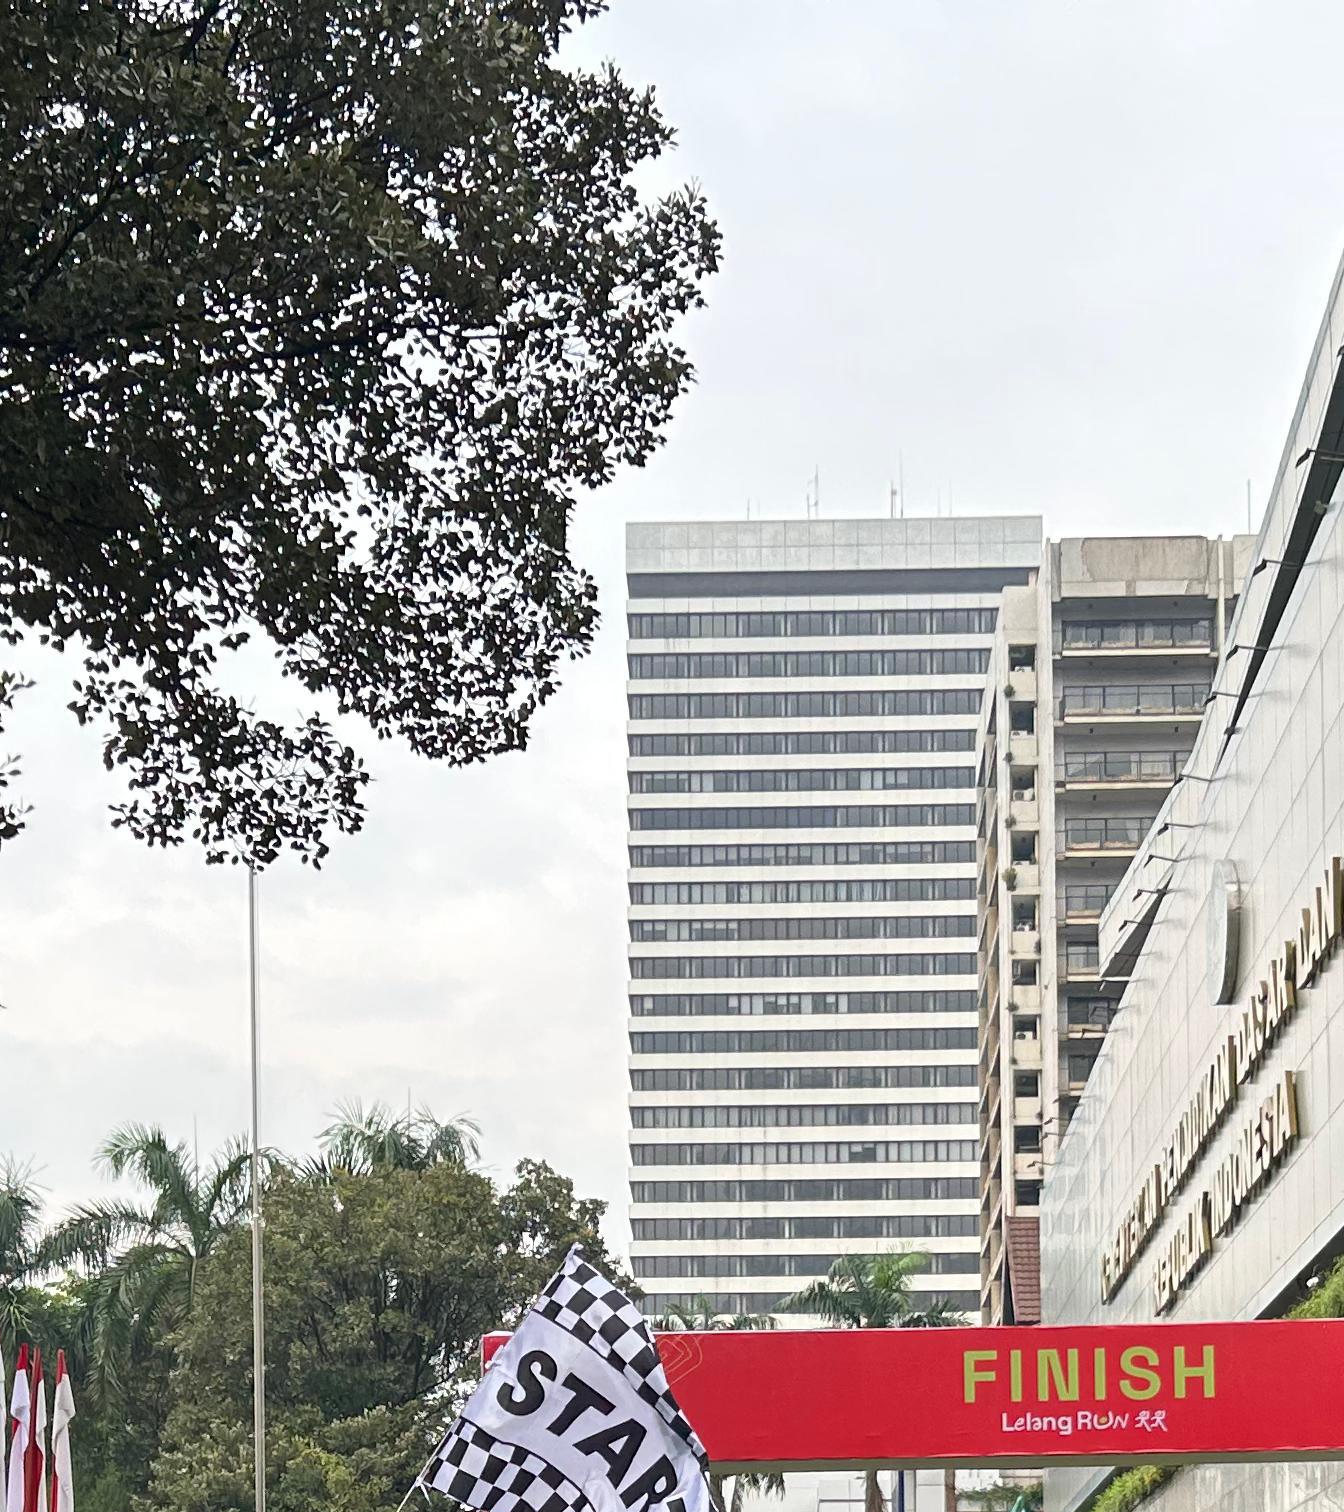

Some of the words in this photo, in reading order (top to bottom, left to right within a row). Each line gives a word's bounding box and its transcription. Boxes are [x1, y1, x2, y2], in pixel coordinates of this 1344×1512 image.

[1237, 940, 1297, 1085] DASAR
[1297, 857, 1344, 989] DAN
[1211, 1070, 1297, 1239] INDONESIA
[963, 1345, 1215, 1403] FINISH
[1001, 1411, 1072, 1436] Lelang
[1077, 1410, 1130, 1430] RUN
